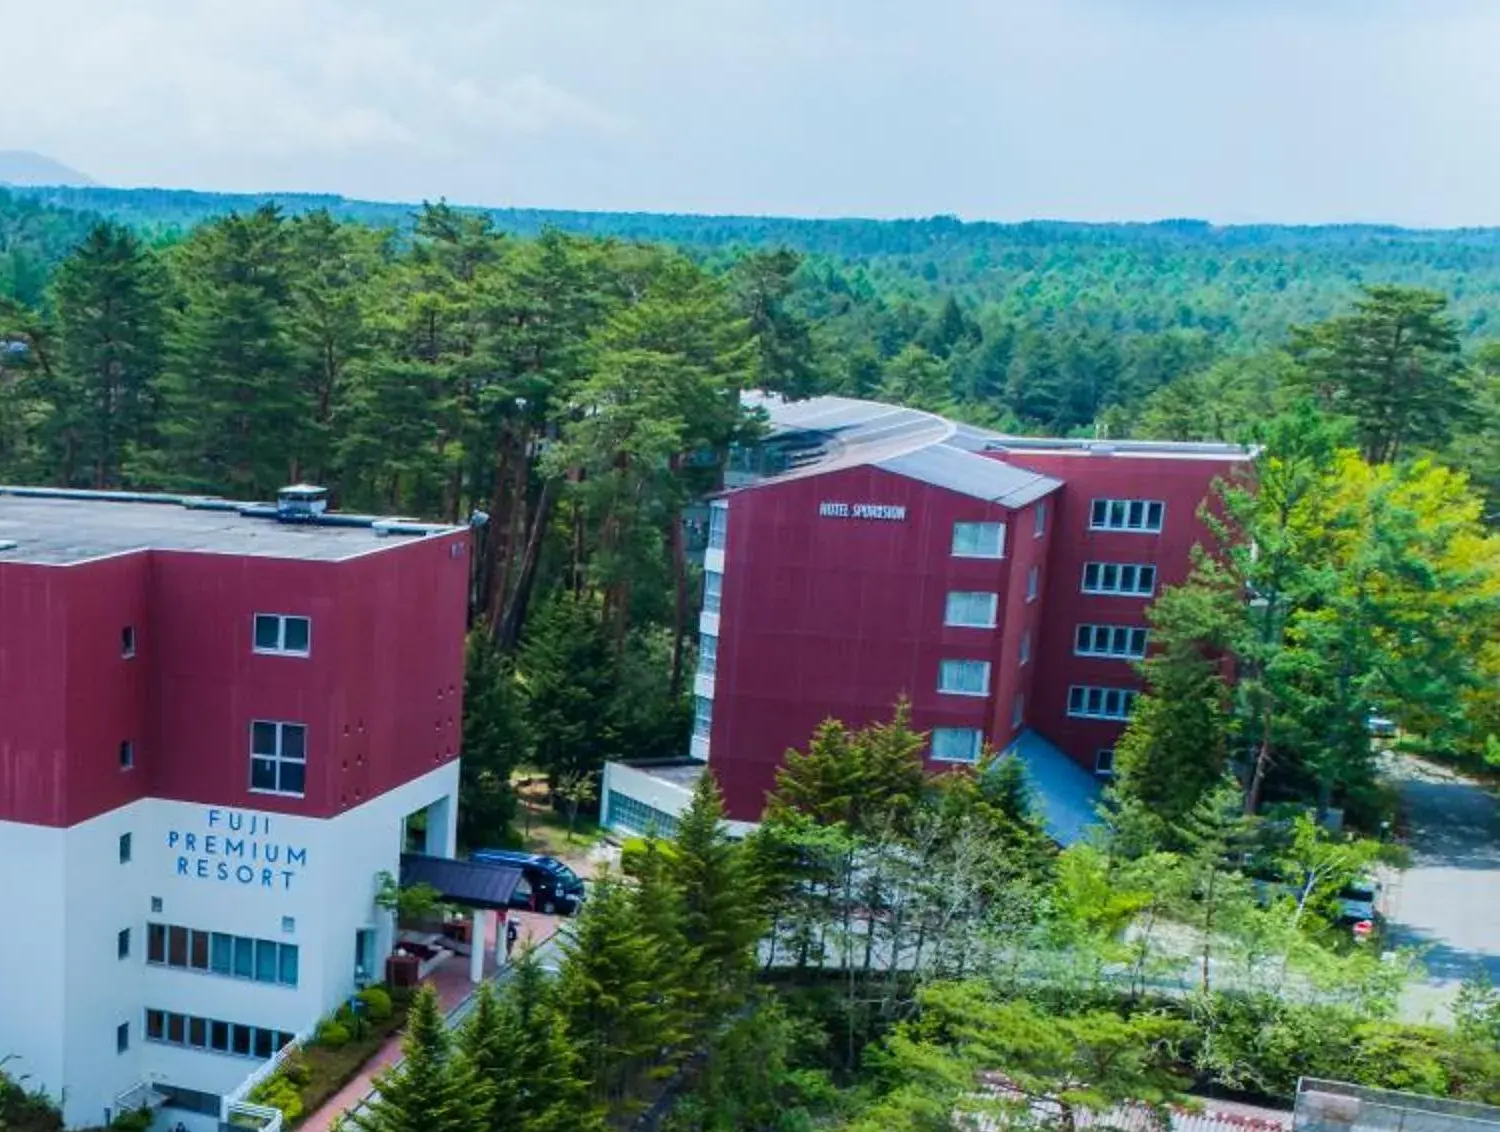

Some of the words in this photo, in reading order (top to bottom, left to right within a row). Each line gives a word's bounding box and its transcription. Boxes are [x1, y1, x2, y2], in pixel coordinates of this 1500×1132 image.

[819, 502, 849, 517] HOTEL
[208, 809, 270, 835] FUJI
[168, 831, 307, 866] PREMIUM
[177, 857, 294, 889] RESORT
